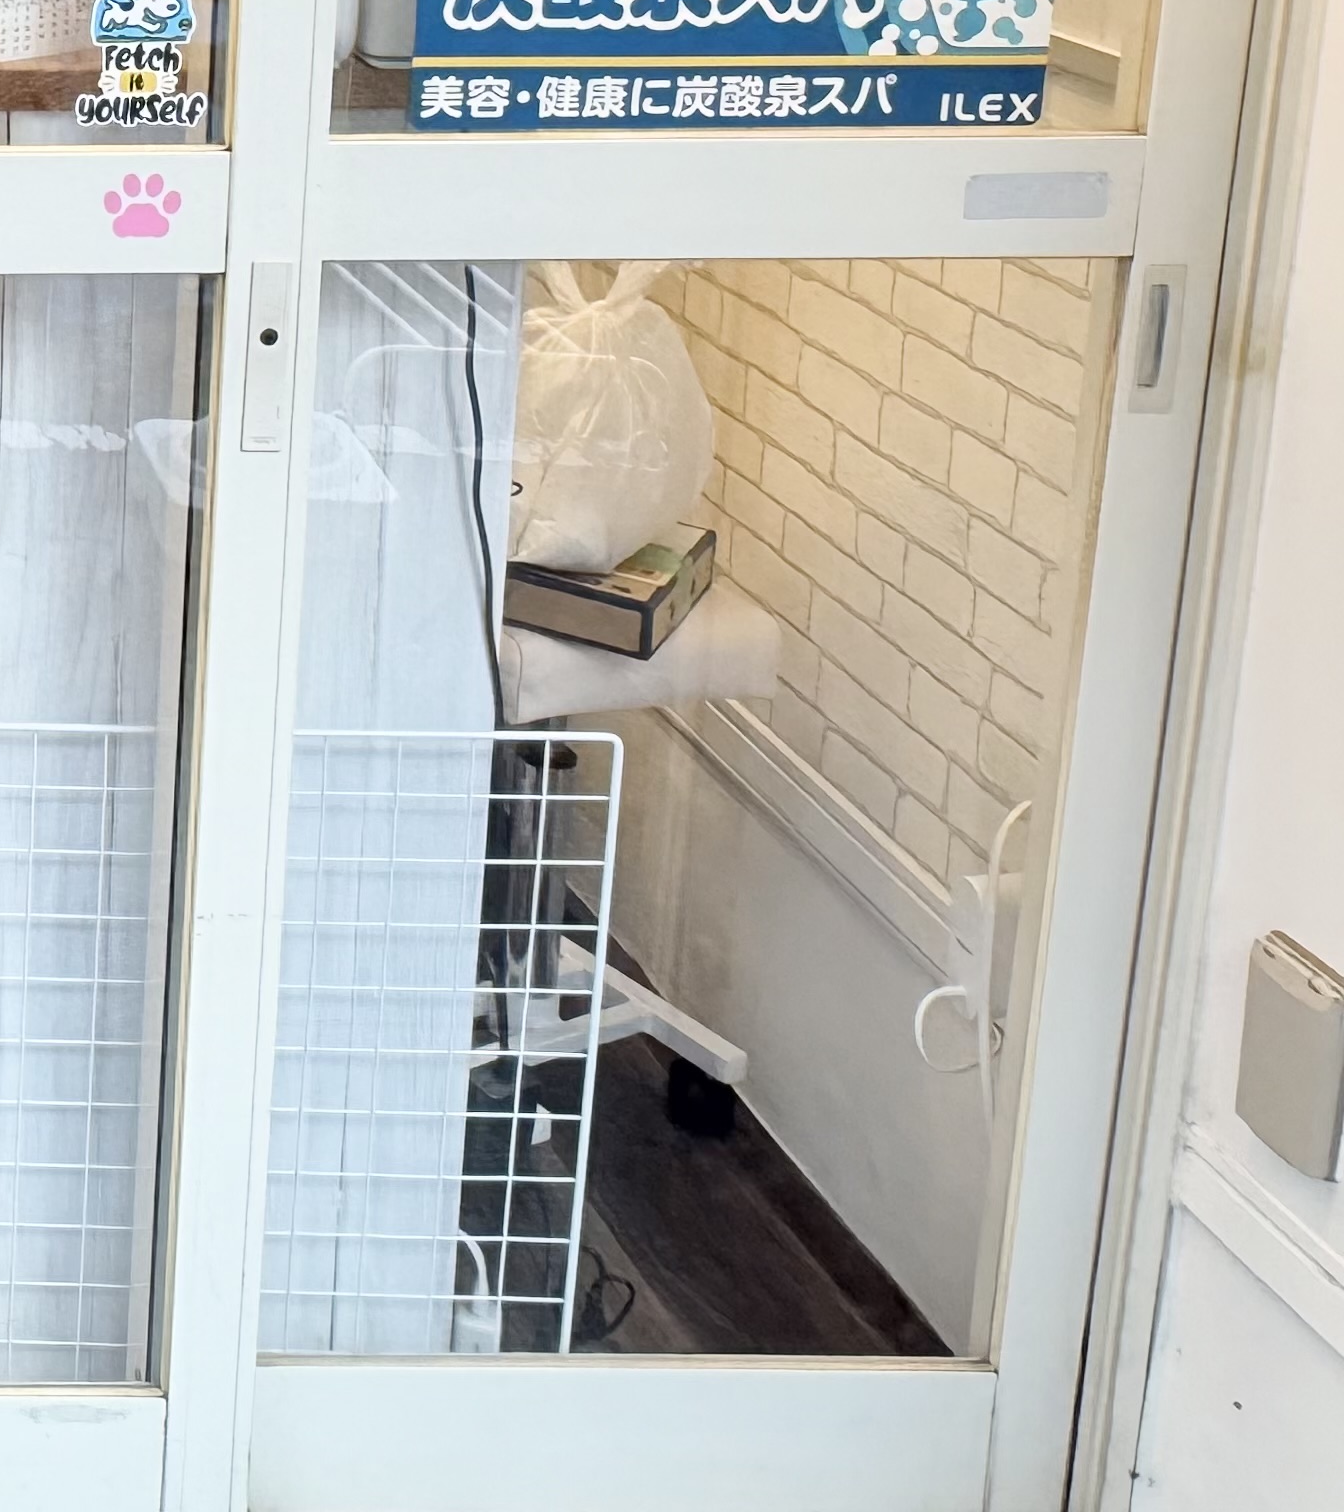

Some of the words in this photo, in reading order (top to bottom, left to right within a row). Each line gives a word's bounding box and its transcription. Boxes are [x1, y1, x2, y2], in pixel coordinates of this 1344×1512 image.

[105, 43, 180, 71] Fetch
[418, 72, 899, 119] 美容・健康に炭酸泉スパ
[939, 92, 1037, 123] ILEX
